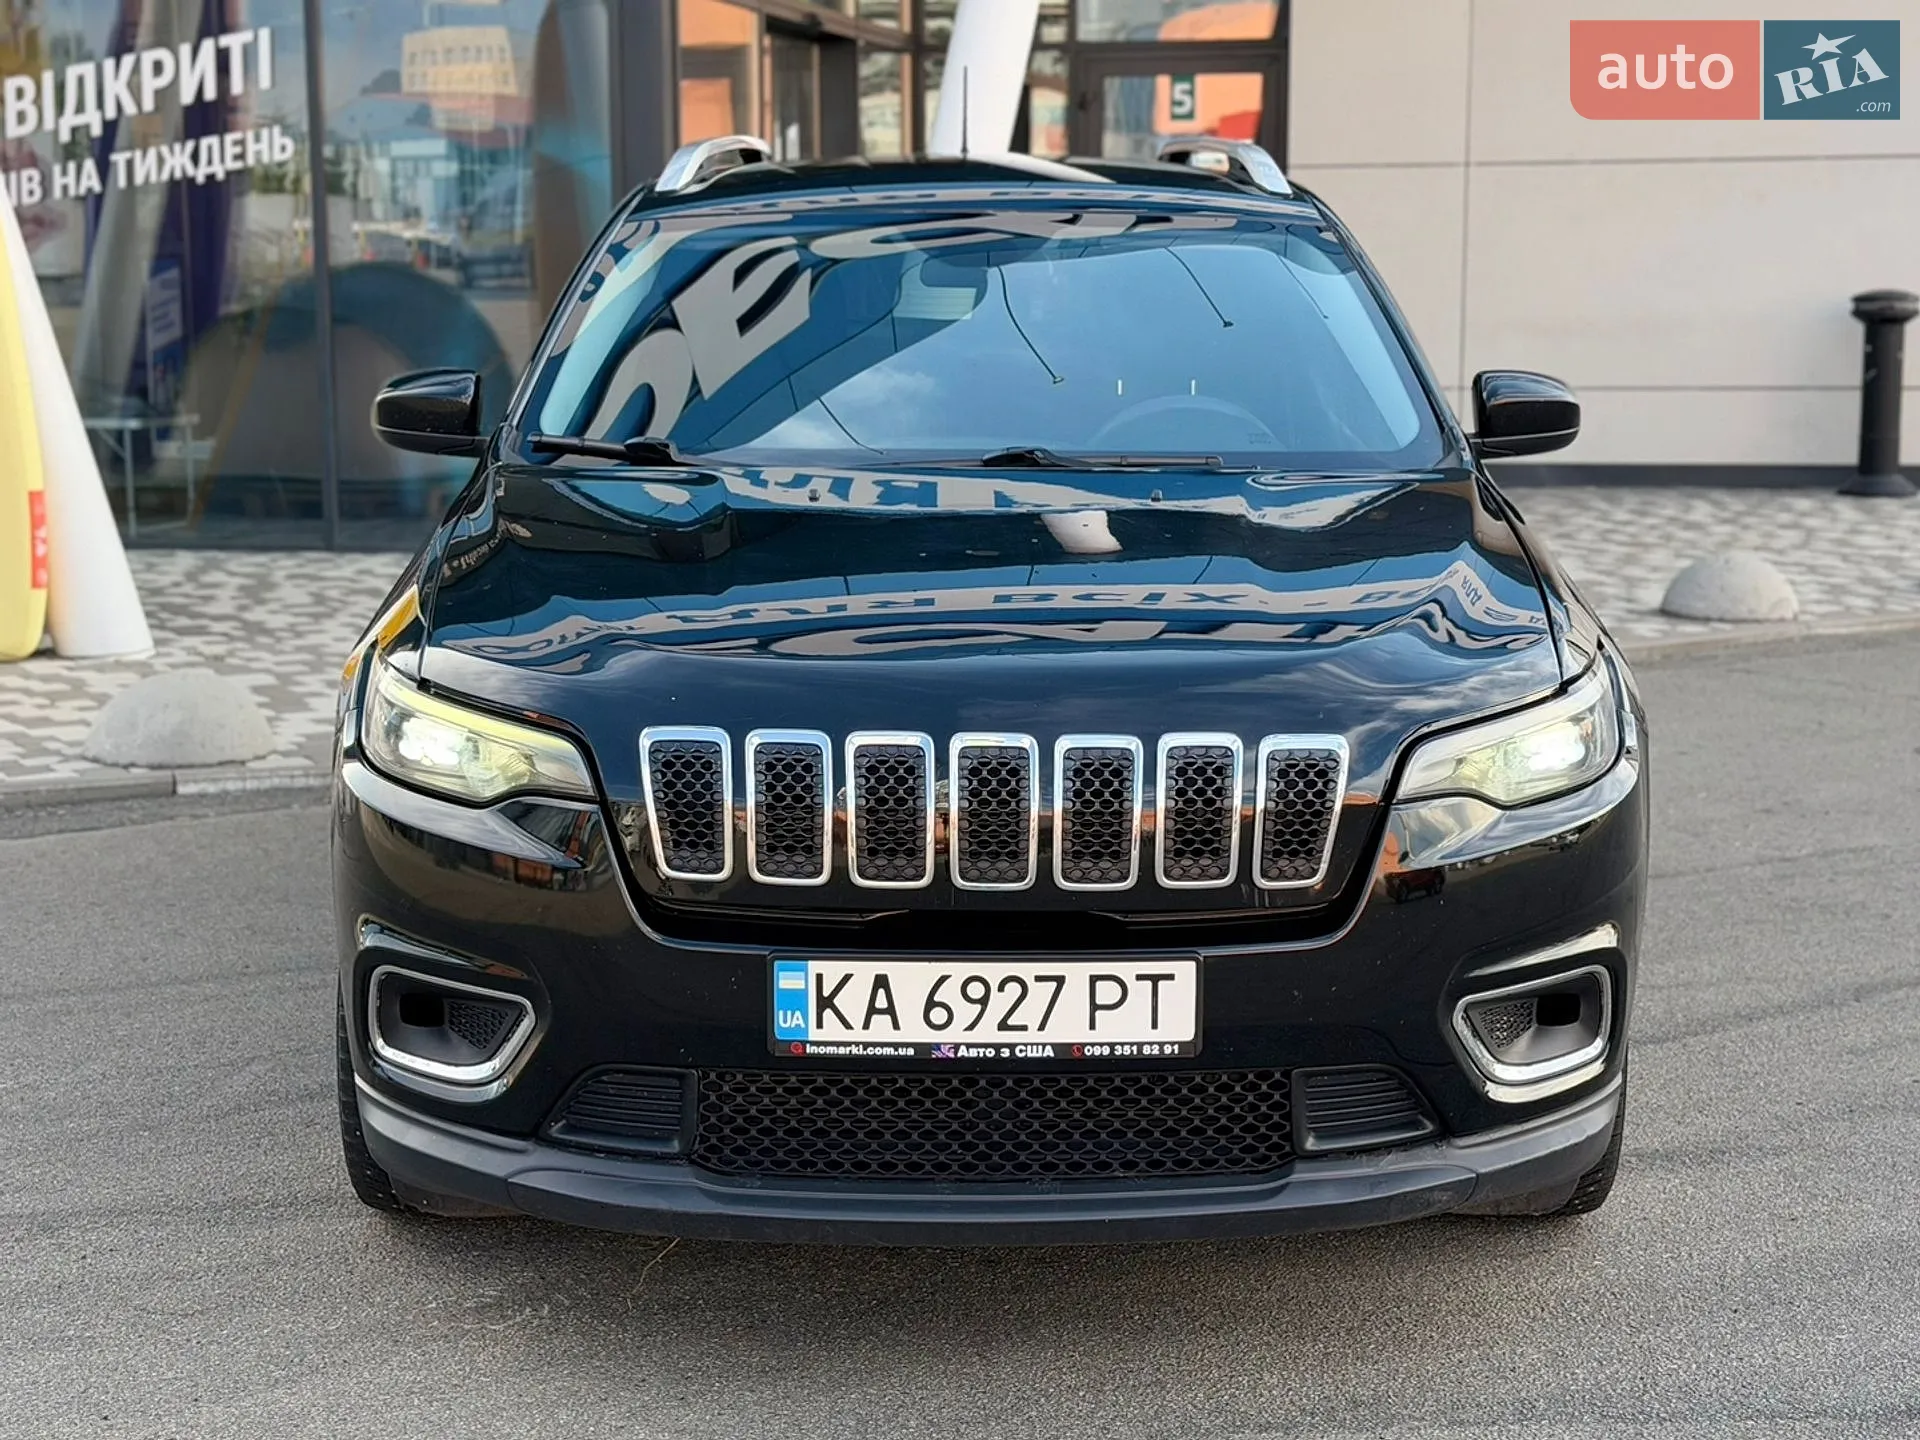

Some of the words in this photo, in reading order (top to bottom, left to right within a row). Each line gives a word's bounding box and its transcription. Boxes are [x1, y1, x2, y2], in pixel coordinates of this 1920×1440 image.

[4, 27, 275, 144] ВІДКРИТІ
[1172, 82, 1193, 116] 5
[0, 166, 43, 208] ІВ
[52, 157, 103, 200] НА
[109, 124, 296, 191] ТИЖДЕНЬ
[778, 1010, 805, 1028] UA
[922, 973, 1066, 1032] 6927
[957, 1044, 996, 1058] Авто
[1015, 1044, 1055, 1058] США
[1084, 1045, 1110, 1056] 099
[1114, 1044, 1138, 1056] 351
[1143, 1044, 1160, 1055] 82
[1164, 1043, 1180, 1055] 91
